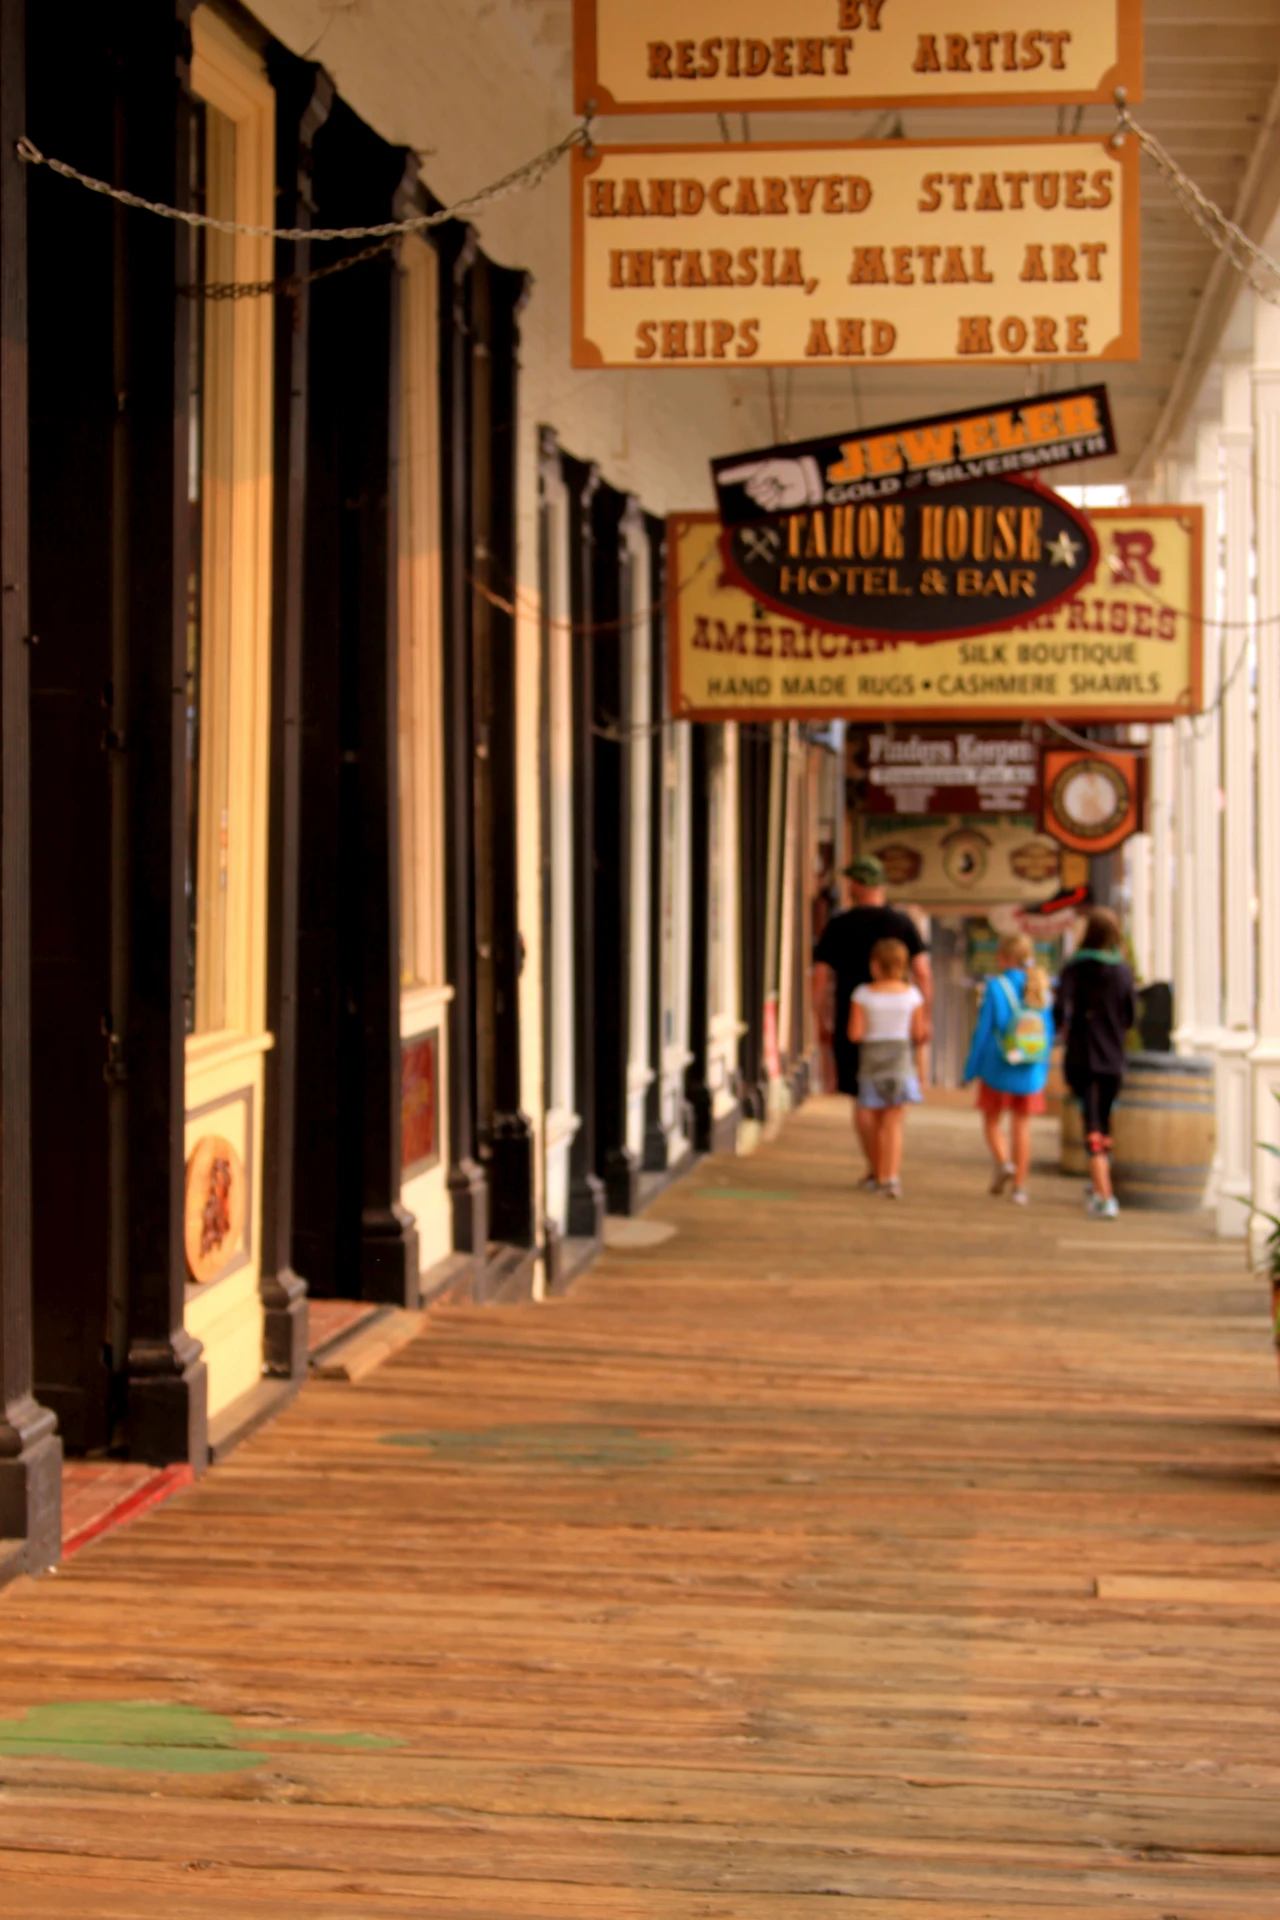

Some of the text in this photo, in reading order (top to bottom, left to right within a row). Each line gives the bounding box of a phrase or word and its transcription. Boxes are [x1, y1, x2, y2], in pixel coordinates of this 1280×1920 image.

[838, 0, 884, 30] BY
[647, 30, 1071, 79] RESIDENT ARTIST
[587, 170, 1113, 218] HANDCARVED STATUES
[609, 243, 1107, 294] INTARSIA, METAL ART
[635, 315, 1088, 359] SHIPS AND MORE
[826, 395, 1102, 484] JEWELER
[826, 477, 900, 504] GOLD
[927, 436, 1107, 486] SILVERSMITH
[780, 503, 1042, 562] TAHOE HOUSE
[1111, 529, 1161, 586] R
[779, 566, 1037, 598] HOTEL & BAR
[958, 641, 1137, 665] SILK BOUTIQUE
[707, 672, 1161, 697] HAND MADE RUGS CASHMERE SHAWLS
